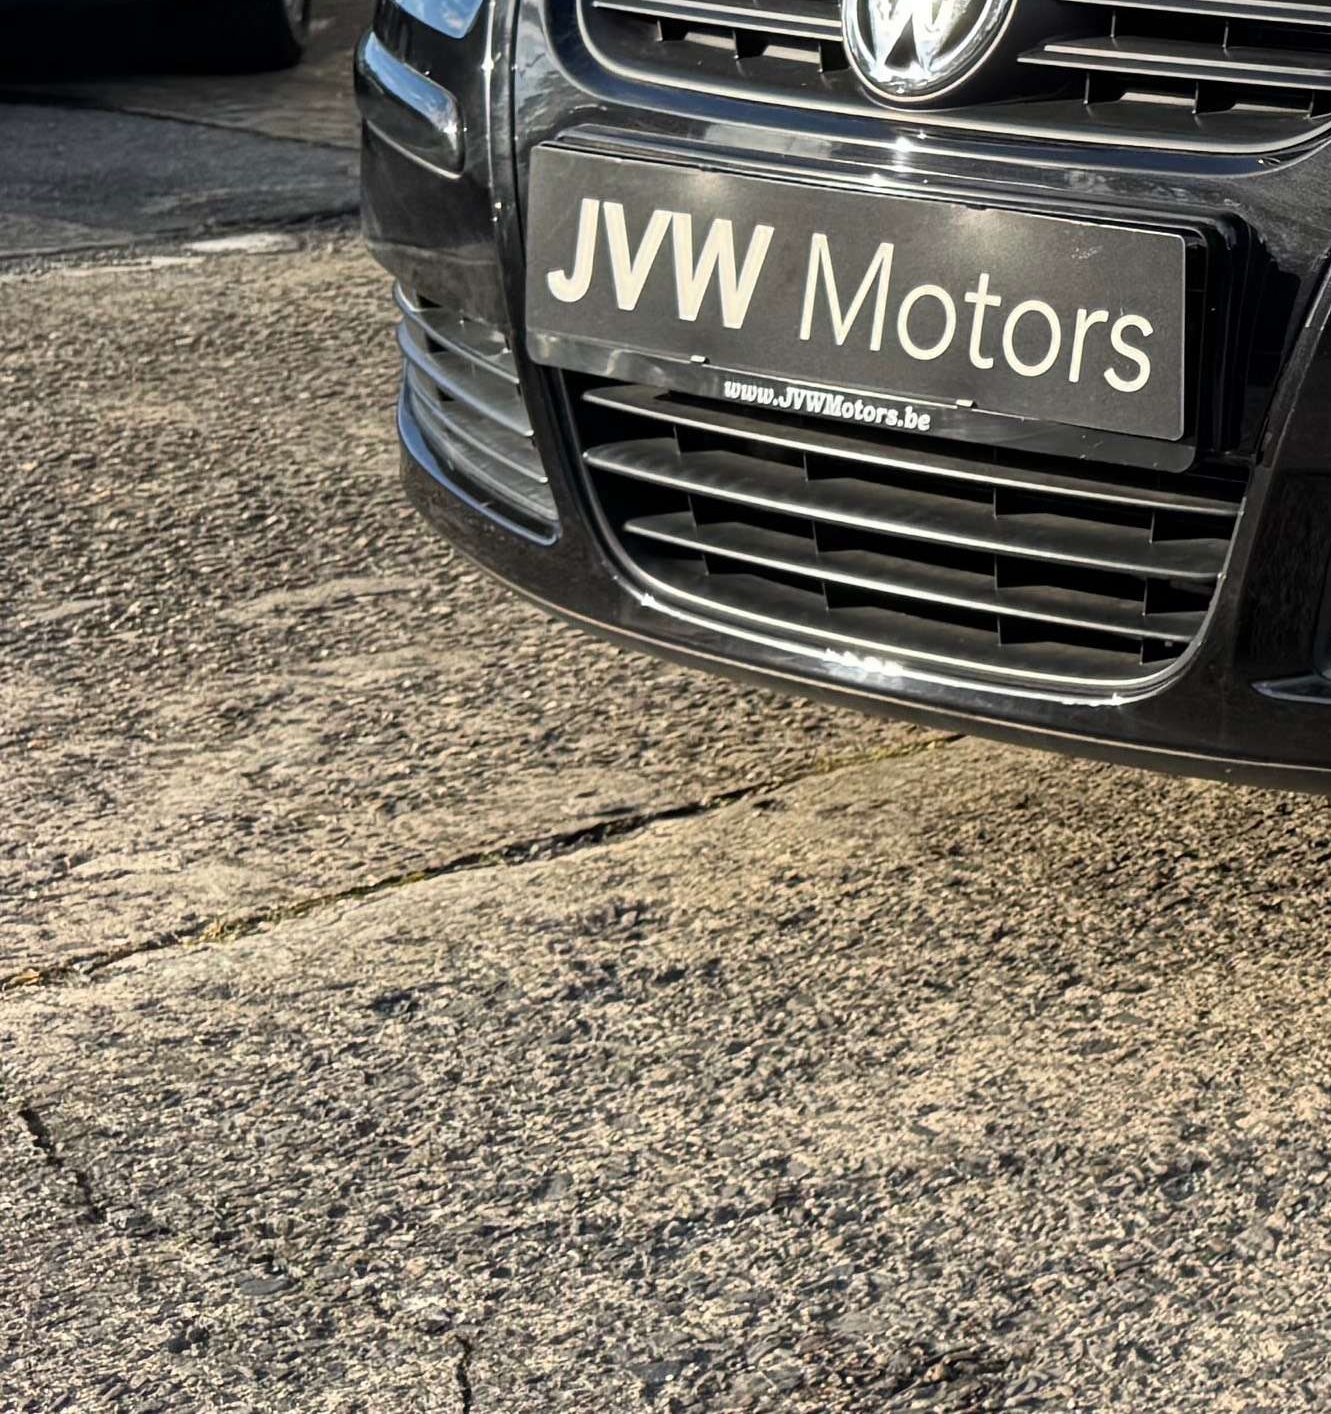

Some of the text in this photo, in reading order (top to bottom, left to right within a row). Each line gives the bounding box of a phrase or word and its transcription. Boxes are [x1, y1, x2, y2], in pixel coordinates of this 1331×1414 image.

[547, 199, 1153, 392] JVW Motors
[724, 381, 931, 431] www.JVWMotors.be
